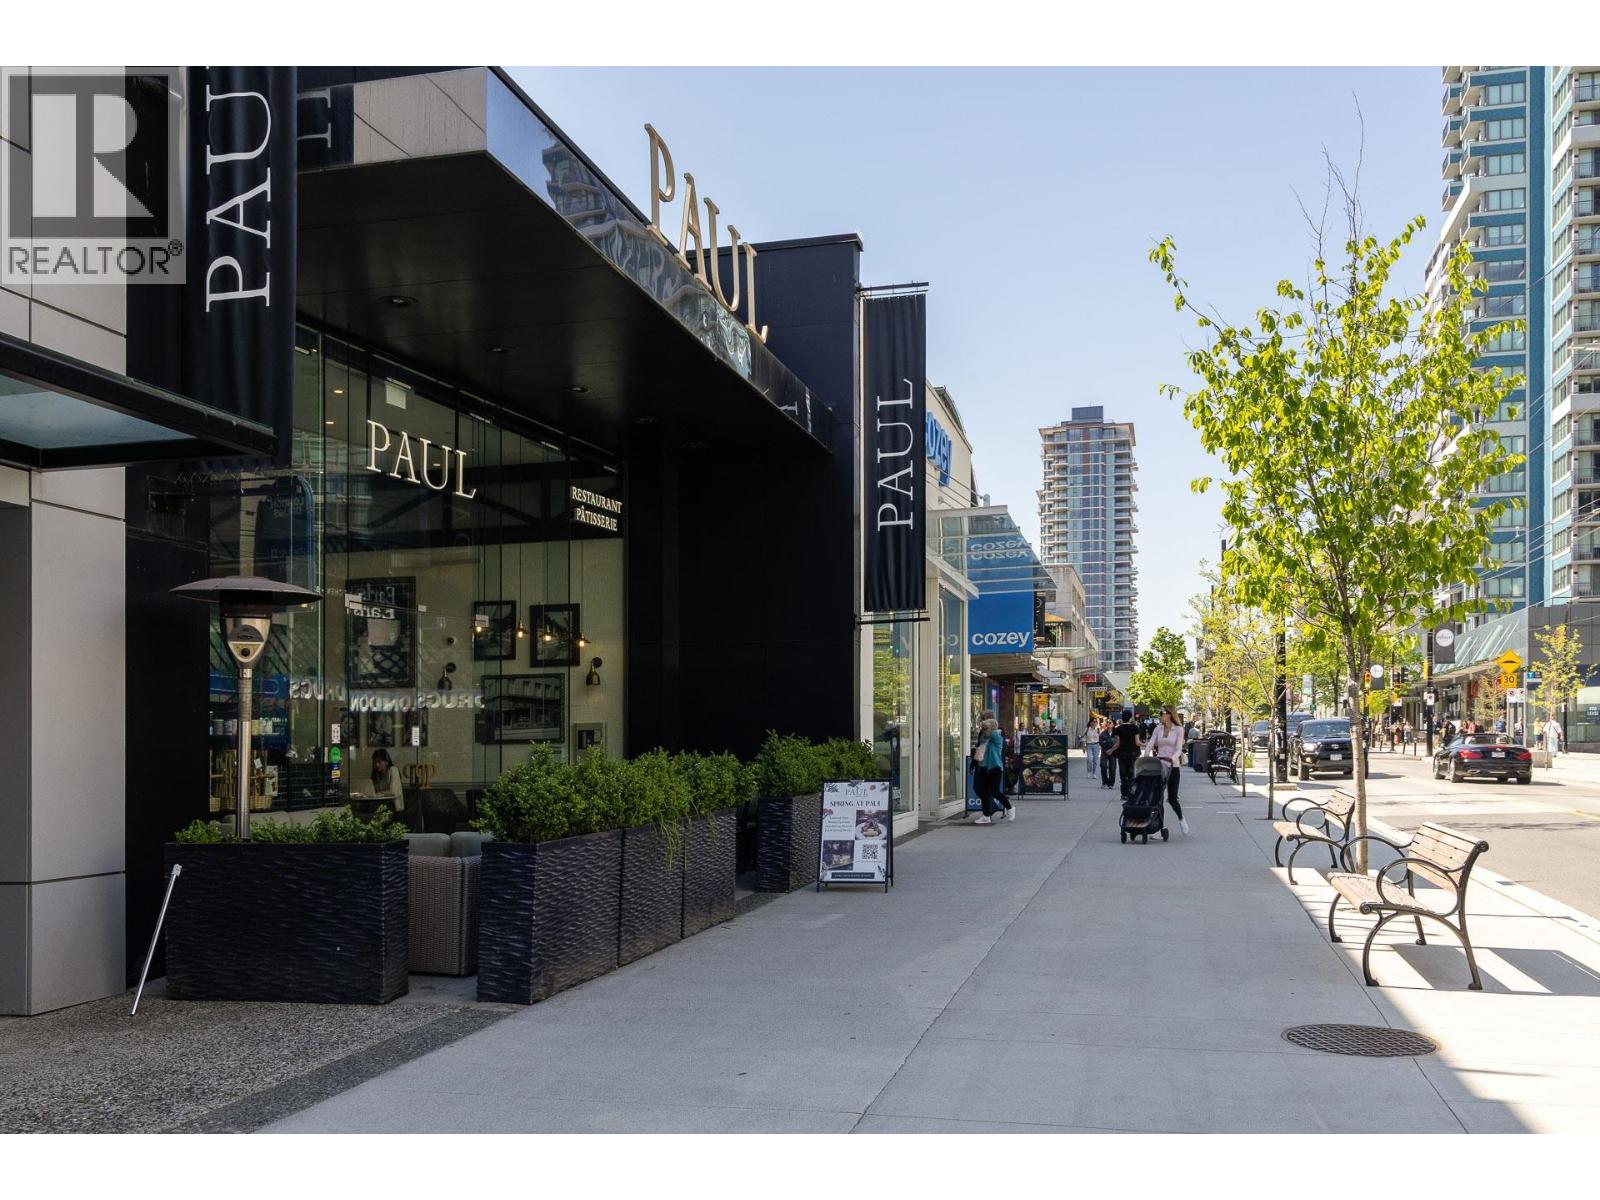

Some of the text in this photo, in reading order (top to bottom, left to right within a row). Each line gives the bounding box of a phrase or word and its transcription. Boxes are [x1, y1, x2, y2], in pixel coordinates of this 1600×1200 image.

[206, 66, 271, 312] PAU
[644, 123, 768, 344] PAUL
[367, 419, 477, 499] PAUL
[877, 378, 914, 532] PAUL
[926, 411, 952, 487] ozey
[571, 486, 623, 513] RESTAURANT
[576, 505, 618, 531] PÂTISSERIE
[971, 631, 1031, 648] cozey
[1503, 675, 1515, 684] 30
[1038, 739, 1050, 747] W
